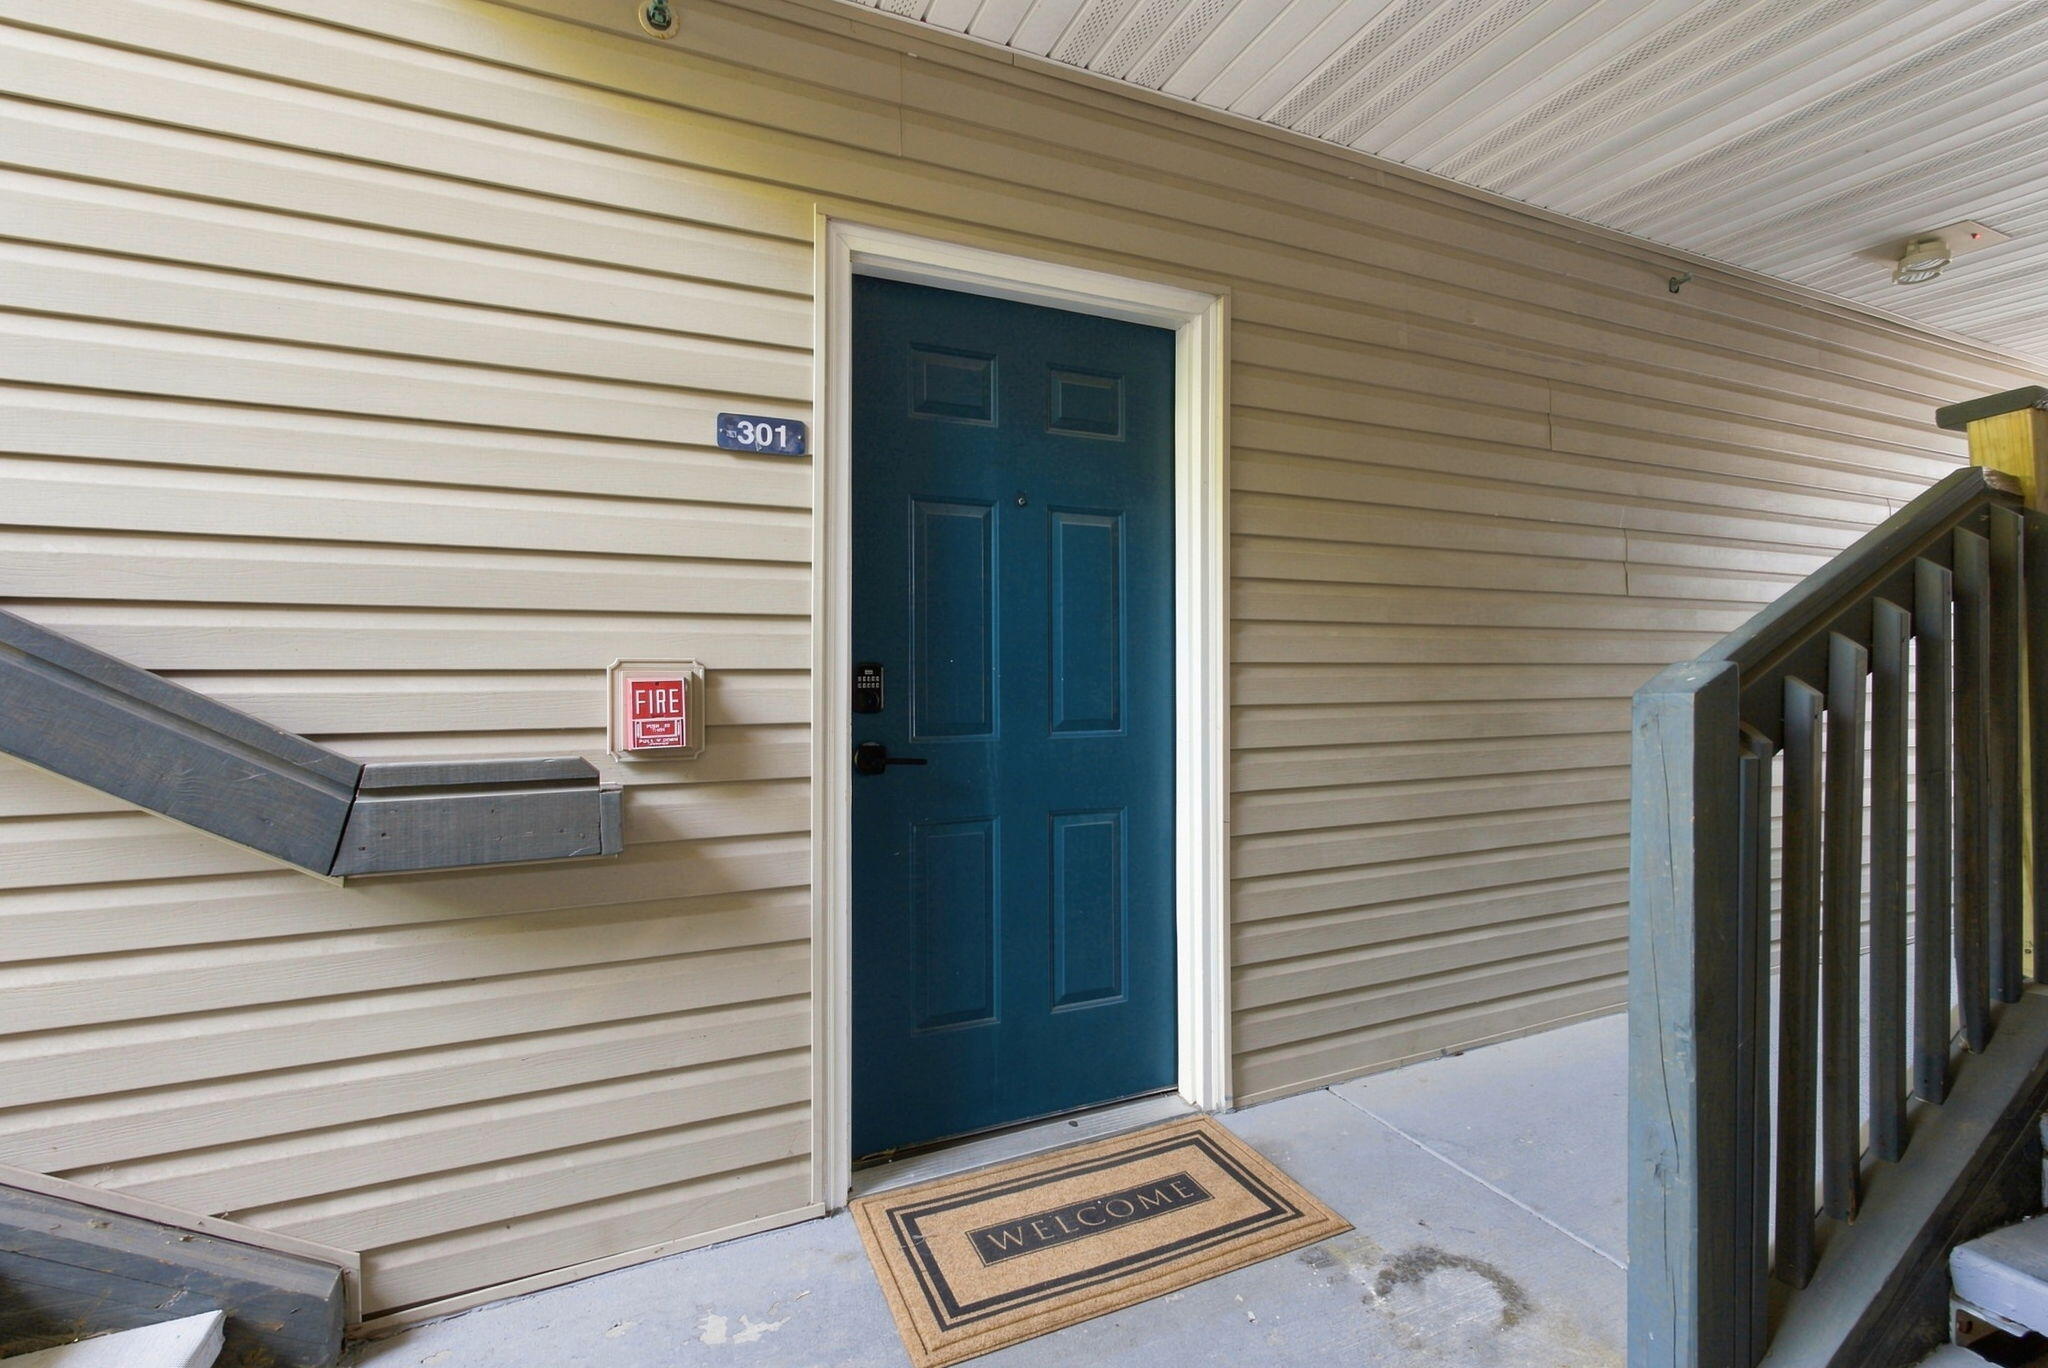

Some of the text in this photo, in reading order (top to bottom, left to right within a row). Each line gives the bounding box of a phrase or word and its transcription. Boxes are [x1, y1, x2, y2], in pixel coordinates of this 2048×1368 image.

[737, 420, 787, 448] 301
[635, 688, 680, 715] FIRE
[986, 1180, 1195, 1250] WELCOME
